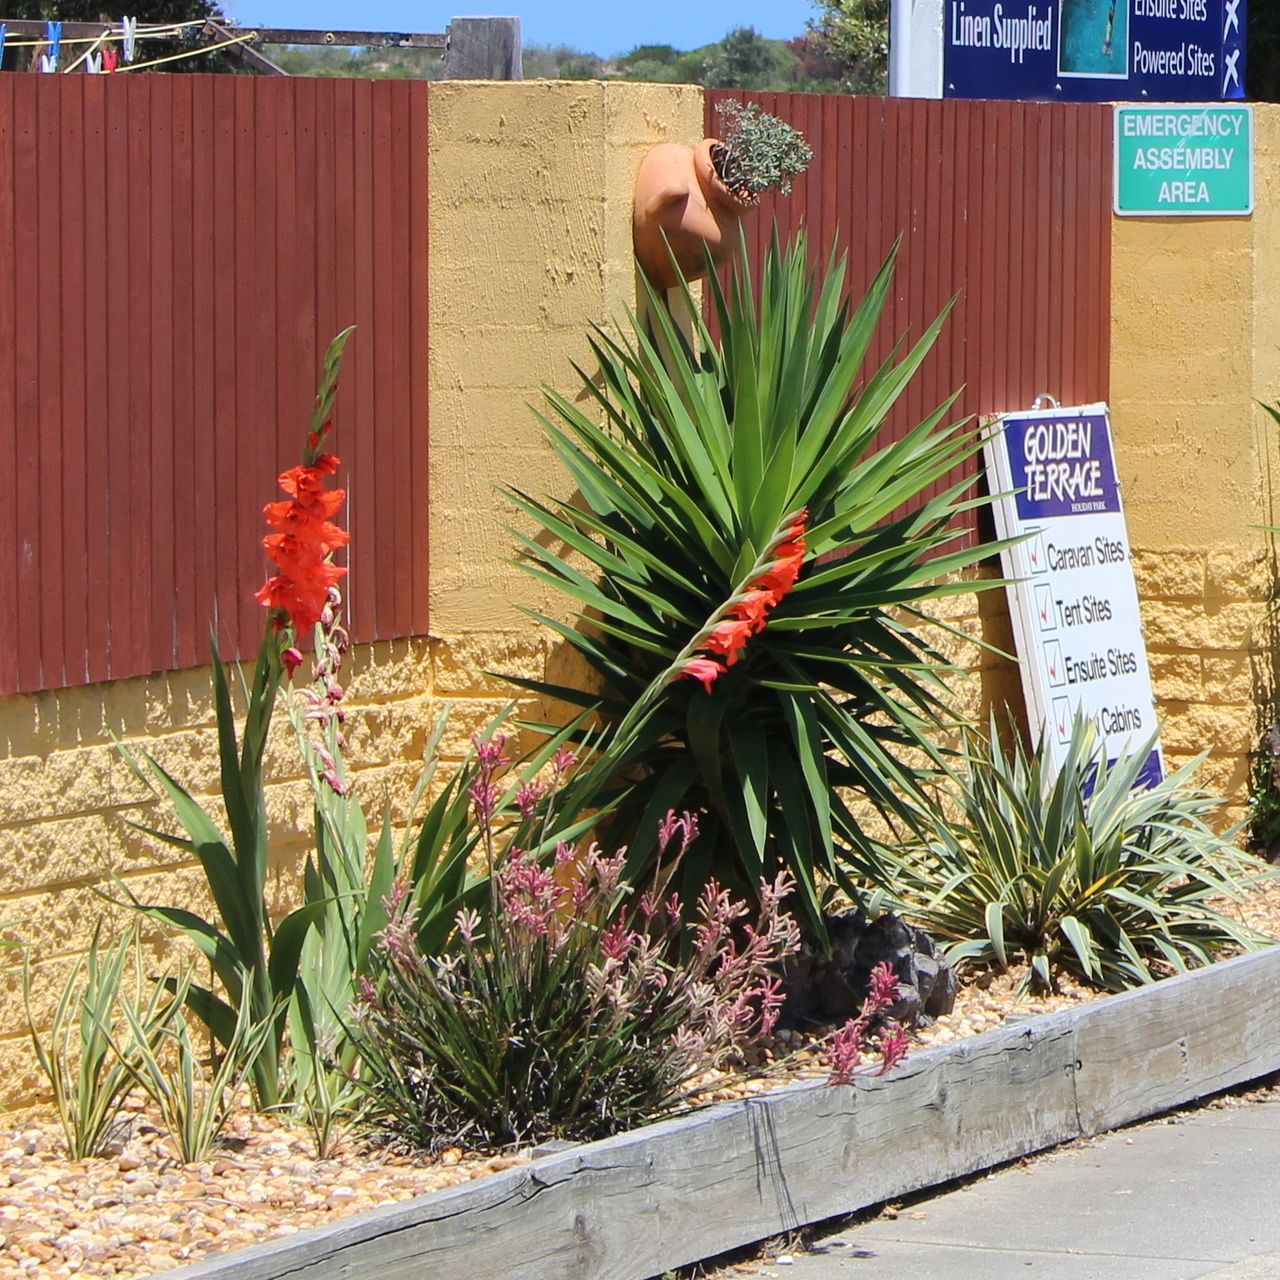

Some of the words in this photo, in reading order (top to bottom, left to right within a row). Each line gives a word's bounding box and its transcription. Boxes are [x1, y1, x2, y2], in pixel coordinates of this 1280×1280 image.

[952, 1, 991, 48] Linen
[993, 3, 1052, 64] Supplied
[1134, 41, 1184, 75] Powered
[1187, 43, 1215, 76] Sites
[1123, 114, 1244, 138] EMERGENCY
[1133, 148, 1234, 171] ASSEMBLY
[1158, 181, 1210, 203] AREA
[1024, 422, 1092, 465] GOLDEN
[1024, 460, 1103, 502] TERRACE
[1071, 502, 1092, 513] HOLIDAY
[1093, 501, 1106, 511] PARK
[1047, 541, 1095, 572] Caravan
[1095, 535, 1125, 566] Sites
[1056, 599, 1083, 627] Tent
[1082, 594, 1112, 623] Sites
[1065, 652, 1107, 685] Ensuite
[1108, 647, 1137, 679] Sites
[1101, 704, 1142, 735] Cabins
